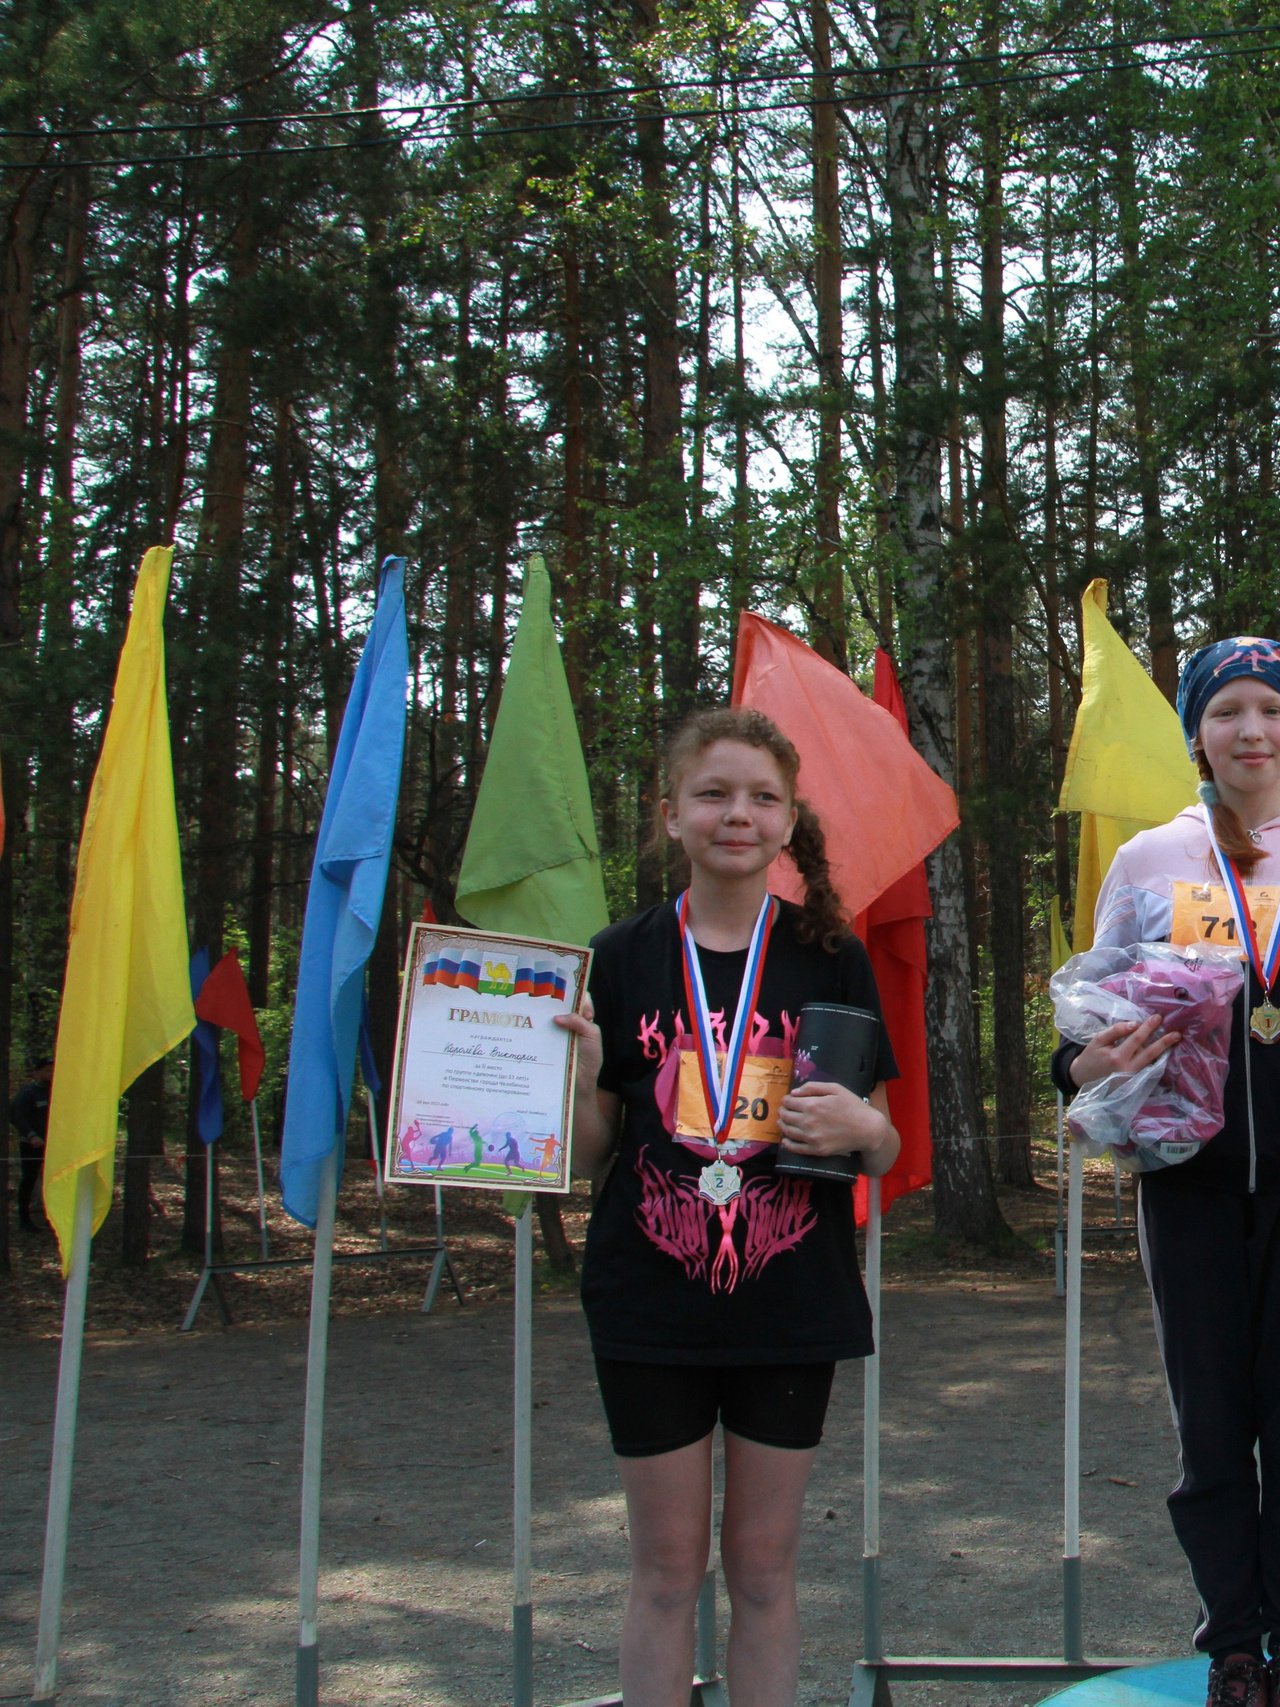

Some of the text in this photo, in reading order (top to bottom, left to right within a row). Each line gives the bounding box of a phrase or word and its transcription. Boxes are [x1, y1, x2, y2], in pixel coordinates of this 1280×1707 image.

[448, 1008, 534, 1029] ГРАМОТА
[1265, 1018, 1271, 1028] 1
[470, 1034, 513, 1042] награждается
[716, 1177, 724, 1188] 2
